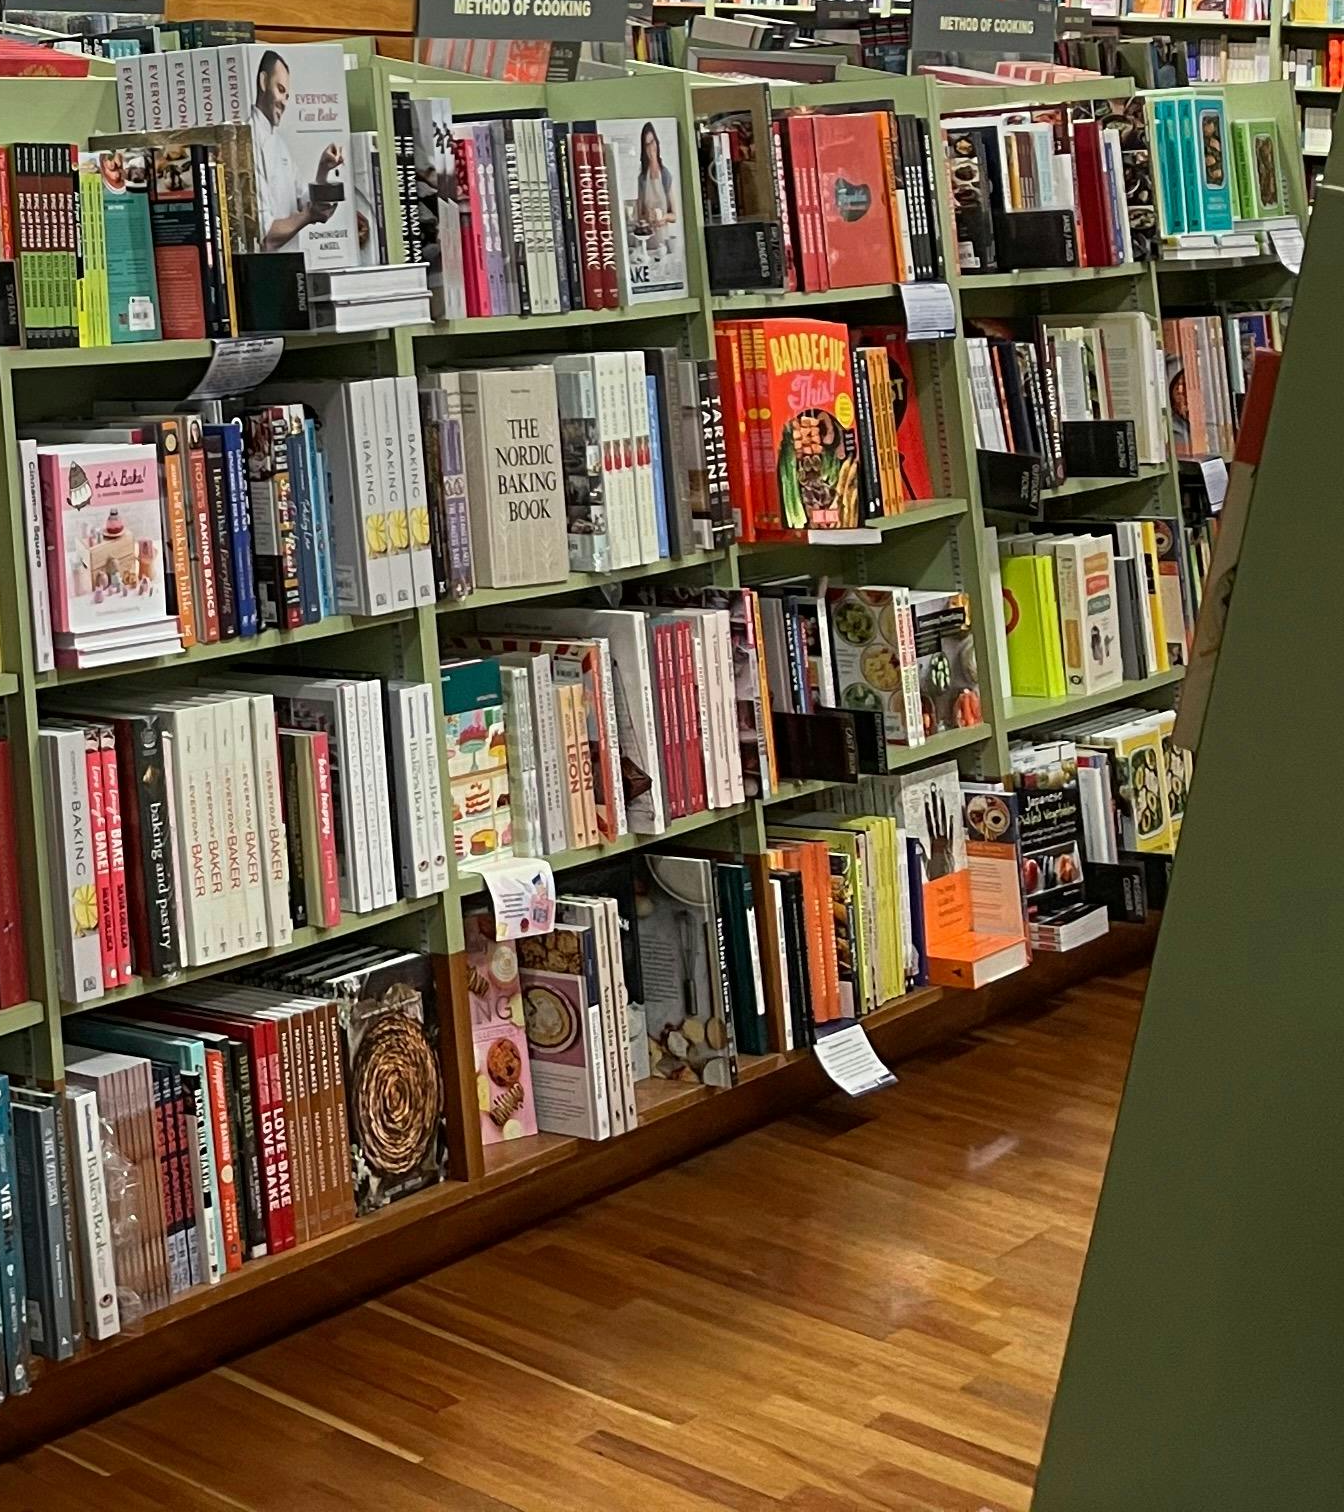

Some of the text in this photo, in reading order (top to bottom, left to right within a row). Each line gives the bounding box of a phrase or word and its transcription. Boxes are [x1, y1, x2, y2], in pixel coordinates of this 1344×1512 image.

[533, 0, 591, 17] COOKING
[940, 16, 1034, 34] METHOD OF COOKING
[295, 93, 338, 106] EVERYONE
[308, 228, 348, 241] DOMINIQUE
[319, 241, 341, 251] ANSEL
[8, 283, 17, 326] SYRIAN
[769, 333, 846, 377] BARBECUE
[788, 372, 835, 410] This!
[508, 418, 539, 440] THE
[700, 399, 718, 495] TARTINE
[711, 395, 729, 492] TARTINE
[362, 440, 376, 507] BAKING
[384, 437, 398, 503] BAKING
[495, 445, 554, 468] NORDIC
[95, 465, 146, 489] Let's Bake!
[508, 498, 552, 523] BOOK
[198, 512, 216, 618] BAKING BASICS
[567, 743, 579, 794] LEON
[581, 742, 593, 790] LEON
[1025, 792, 1063, 812] Japanese
[150, 802, 172, 951] baking and pastry
